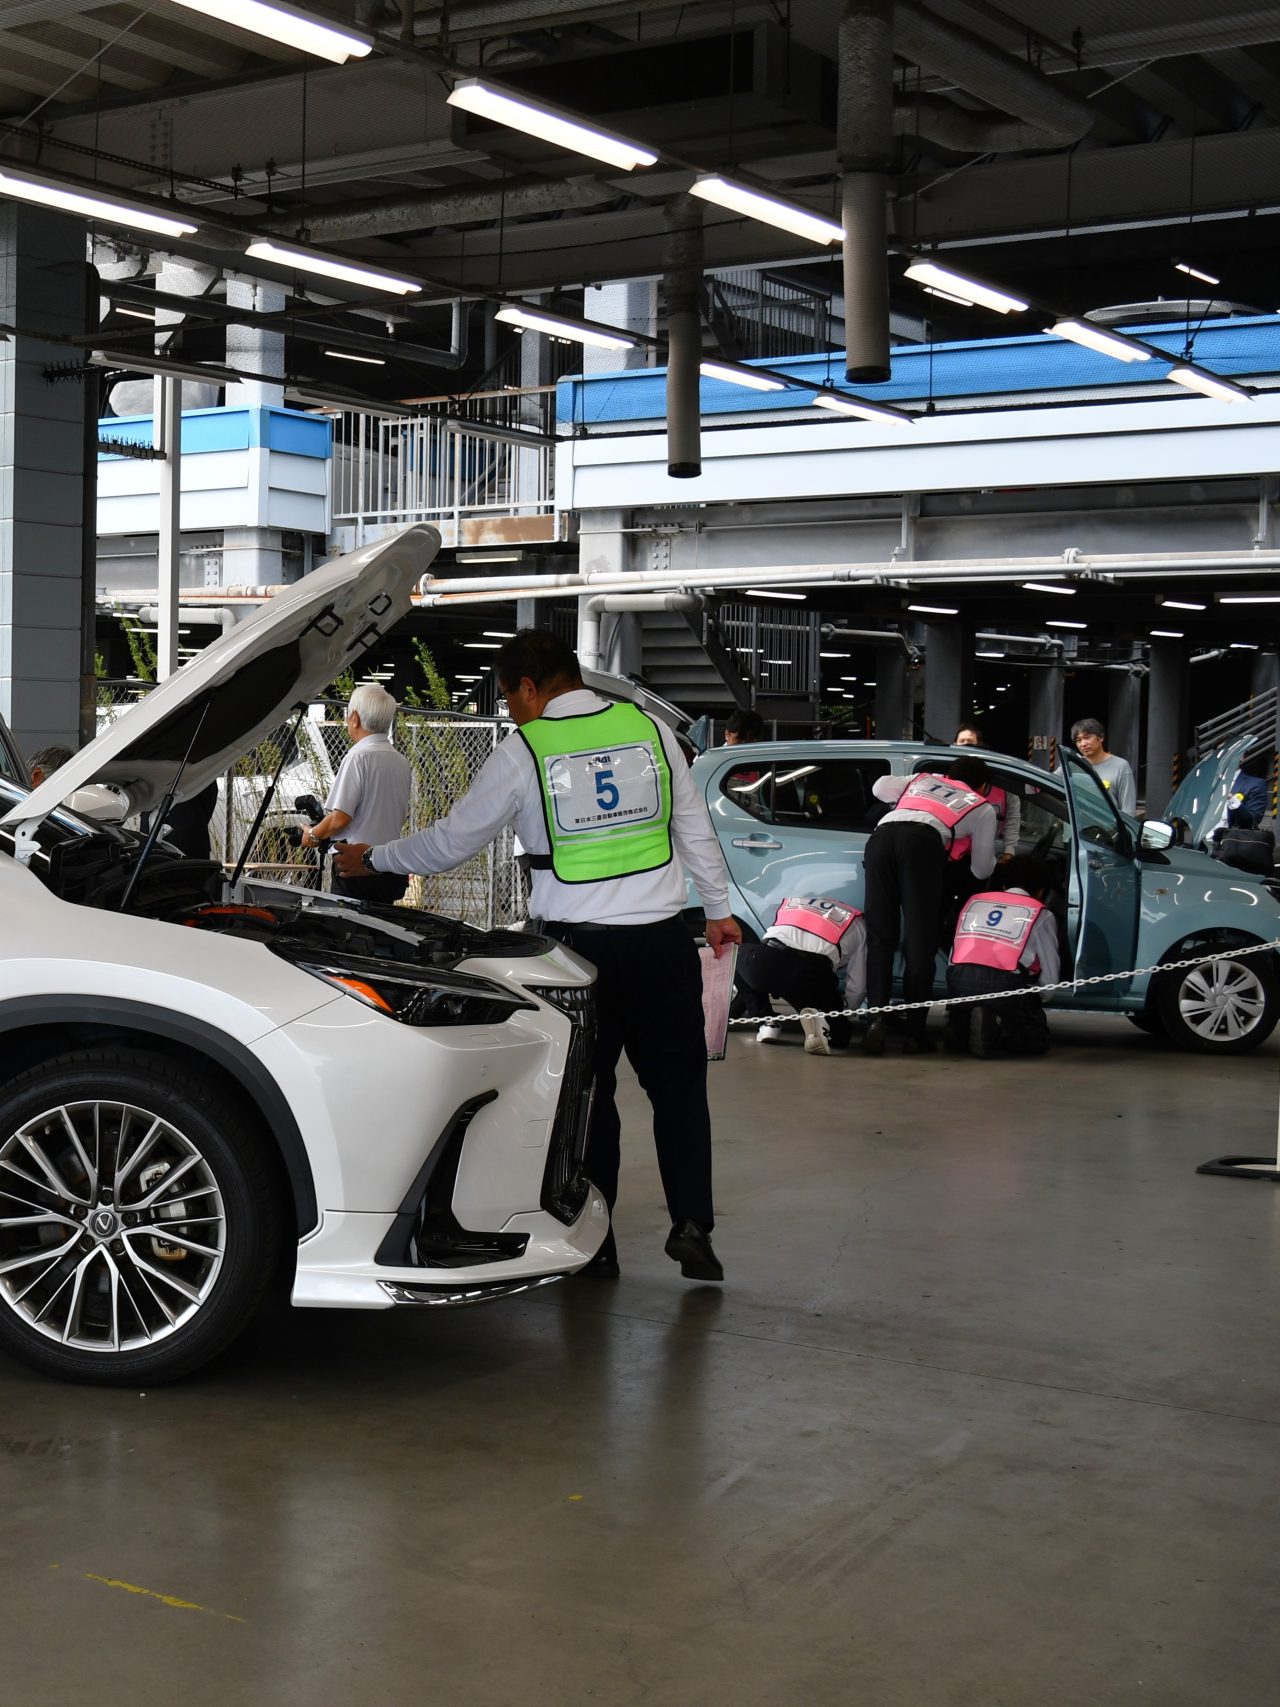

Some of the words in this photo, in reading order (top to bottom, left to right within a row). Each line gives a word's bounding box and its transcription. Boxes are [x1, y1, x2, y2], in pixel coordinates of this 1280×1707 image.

[594, 769, 620, 811] 5
[928, 784, 957, 798] 11
[985, 909, 1003, 927] 9
